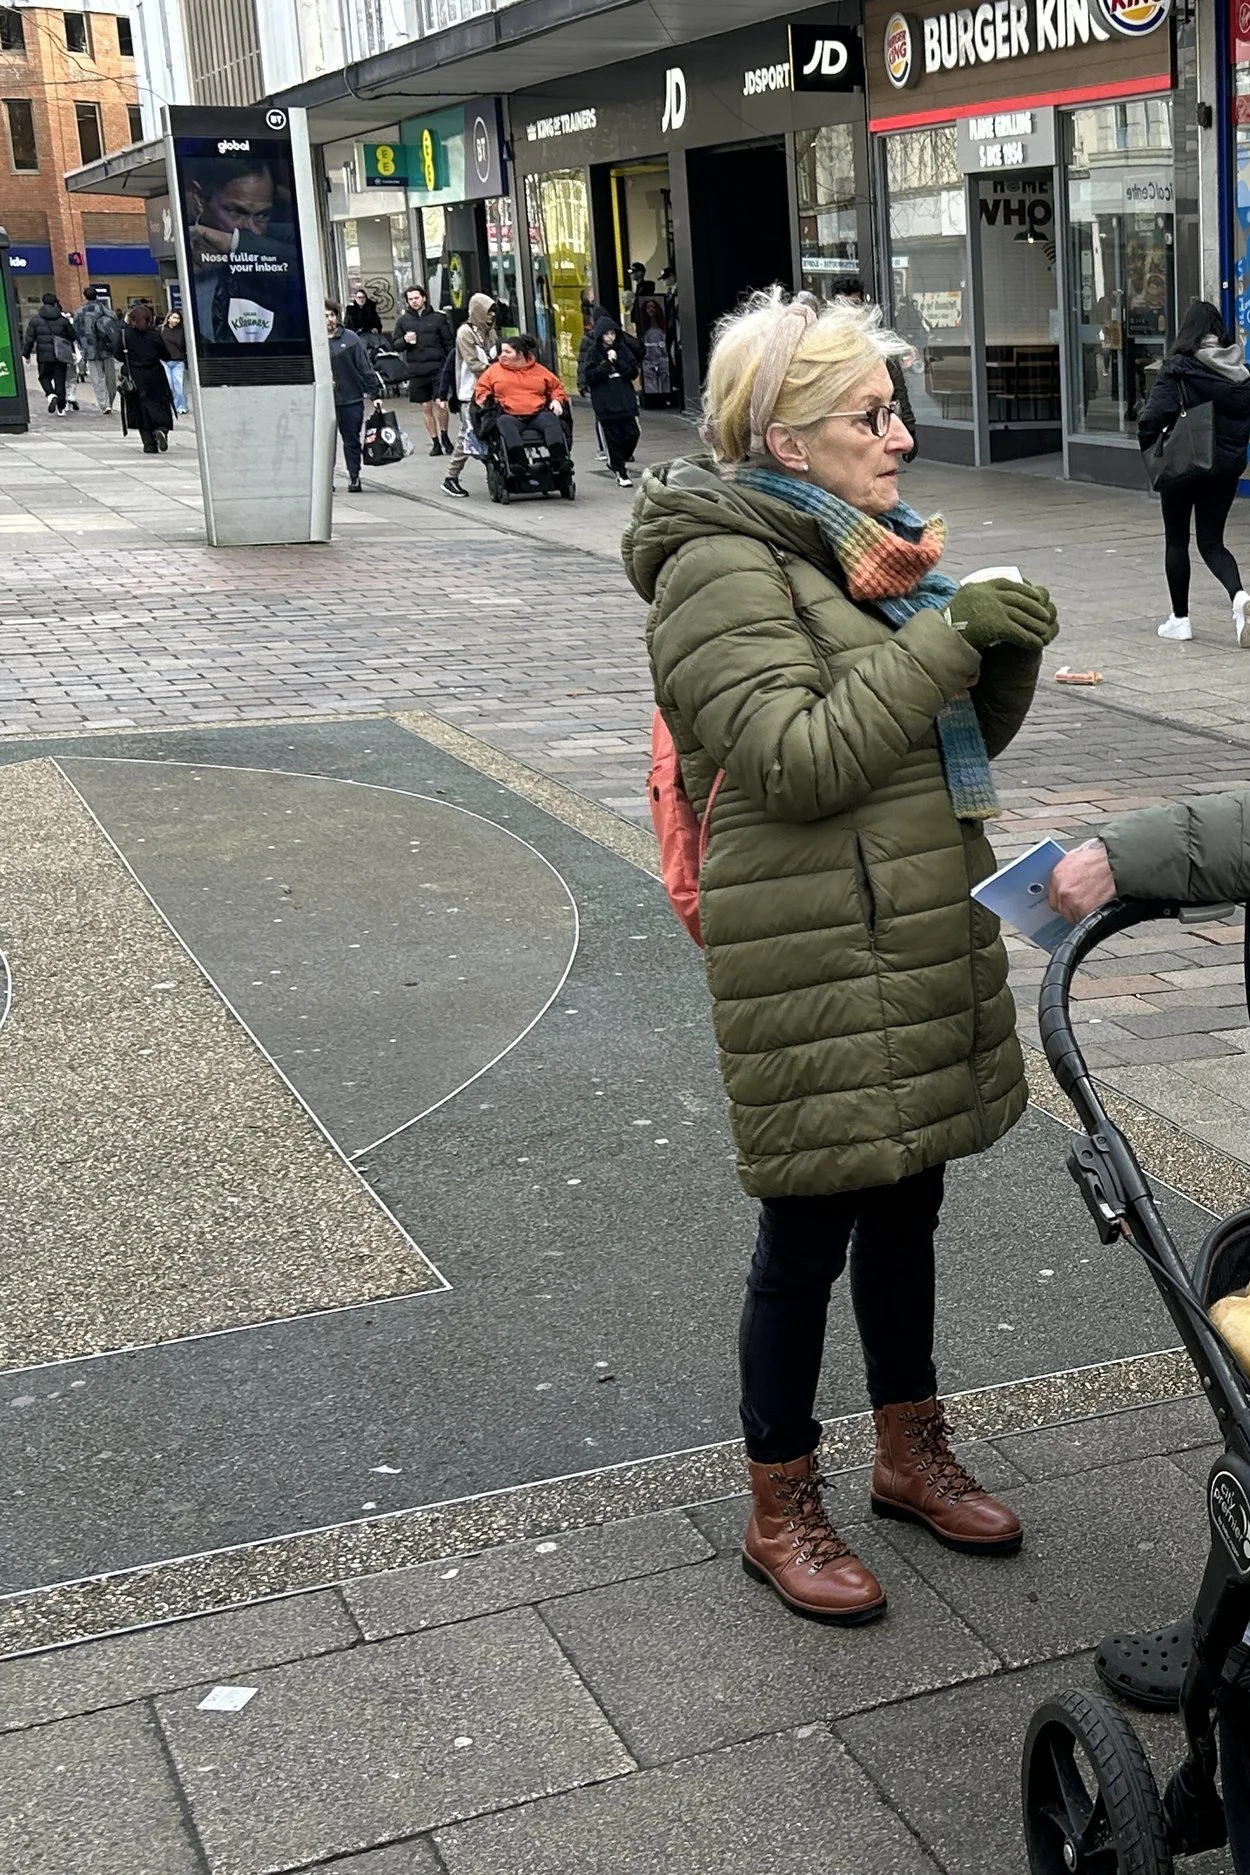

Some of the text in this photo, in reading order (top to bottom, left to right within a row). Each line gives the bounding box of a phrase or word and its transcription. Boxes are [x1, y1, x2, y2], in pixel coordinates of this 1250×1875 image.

[924, 0, 1030, 73] BURGER
[803, 40, 848, 75] JD
[743, 62, 790, 96] JDSPORT
[662, 67, 687, 133] JD
[537, 117, 554, 139] KING
[560, 108, 597, 134] TRAINERS
[217, 140, 250, 154] global
[476, 137, 486, 162] BT
[201, 252, 228, 263] Nose
[229, 252, 259, 263] fuller
[229, 262, 288, 274] your inbox?
[1220, 1483, 1236, 1510] city
[1213, 1487, 1244, 1542] premier
